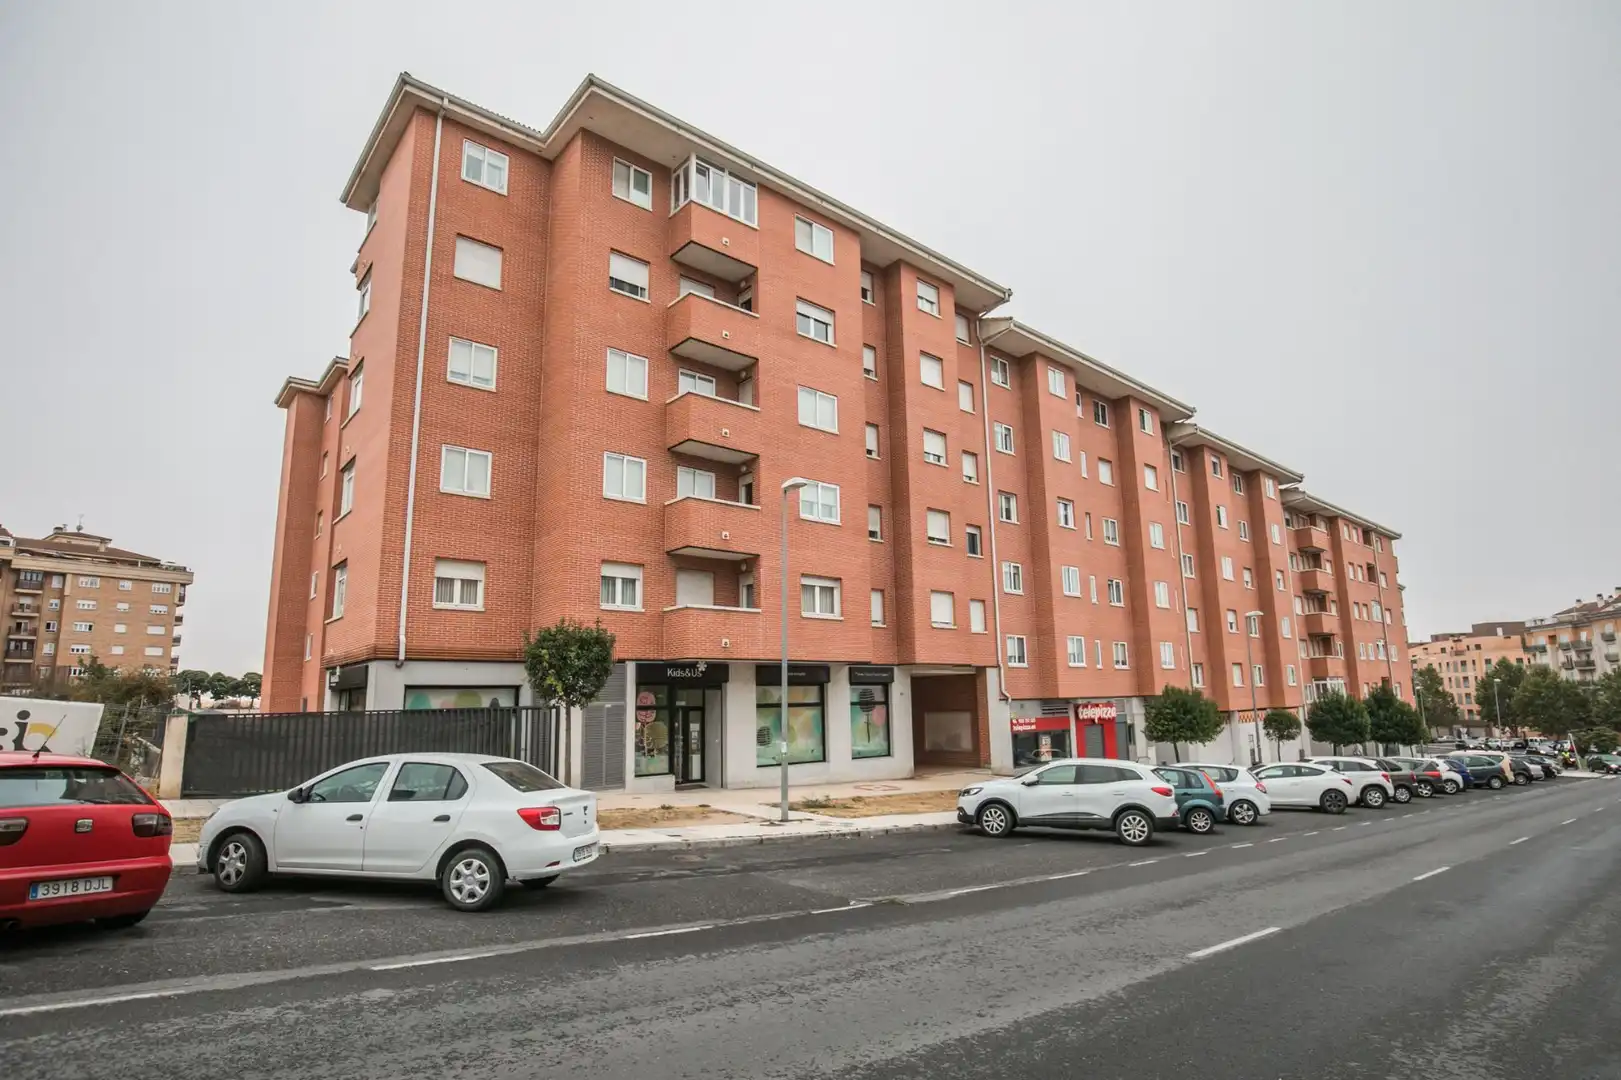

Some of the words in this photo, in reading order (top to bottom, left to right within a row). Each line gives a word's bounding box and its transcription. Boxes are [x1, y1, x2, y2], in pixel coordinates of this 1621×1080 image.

[1078, 703, 1117, 724] telepizza
[41, 880, 79, 896] 3918
[84, 879, 108, 891] DJL
